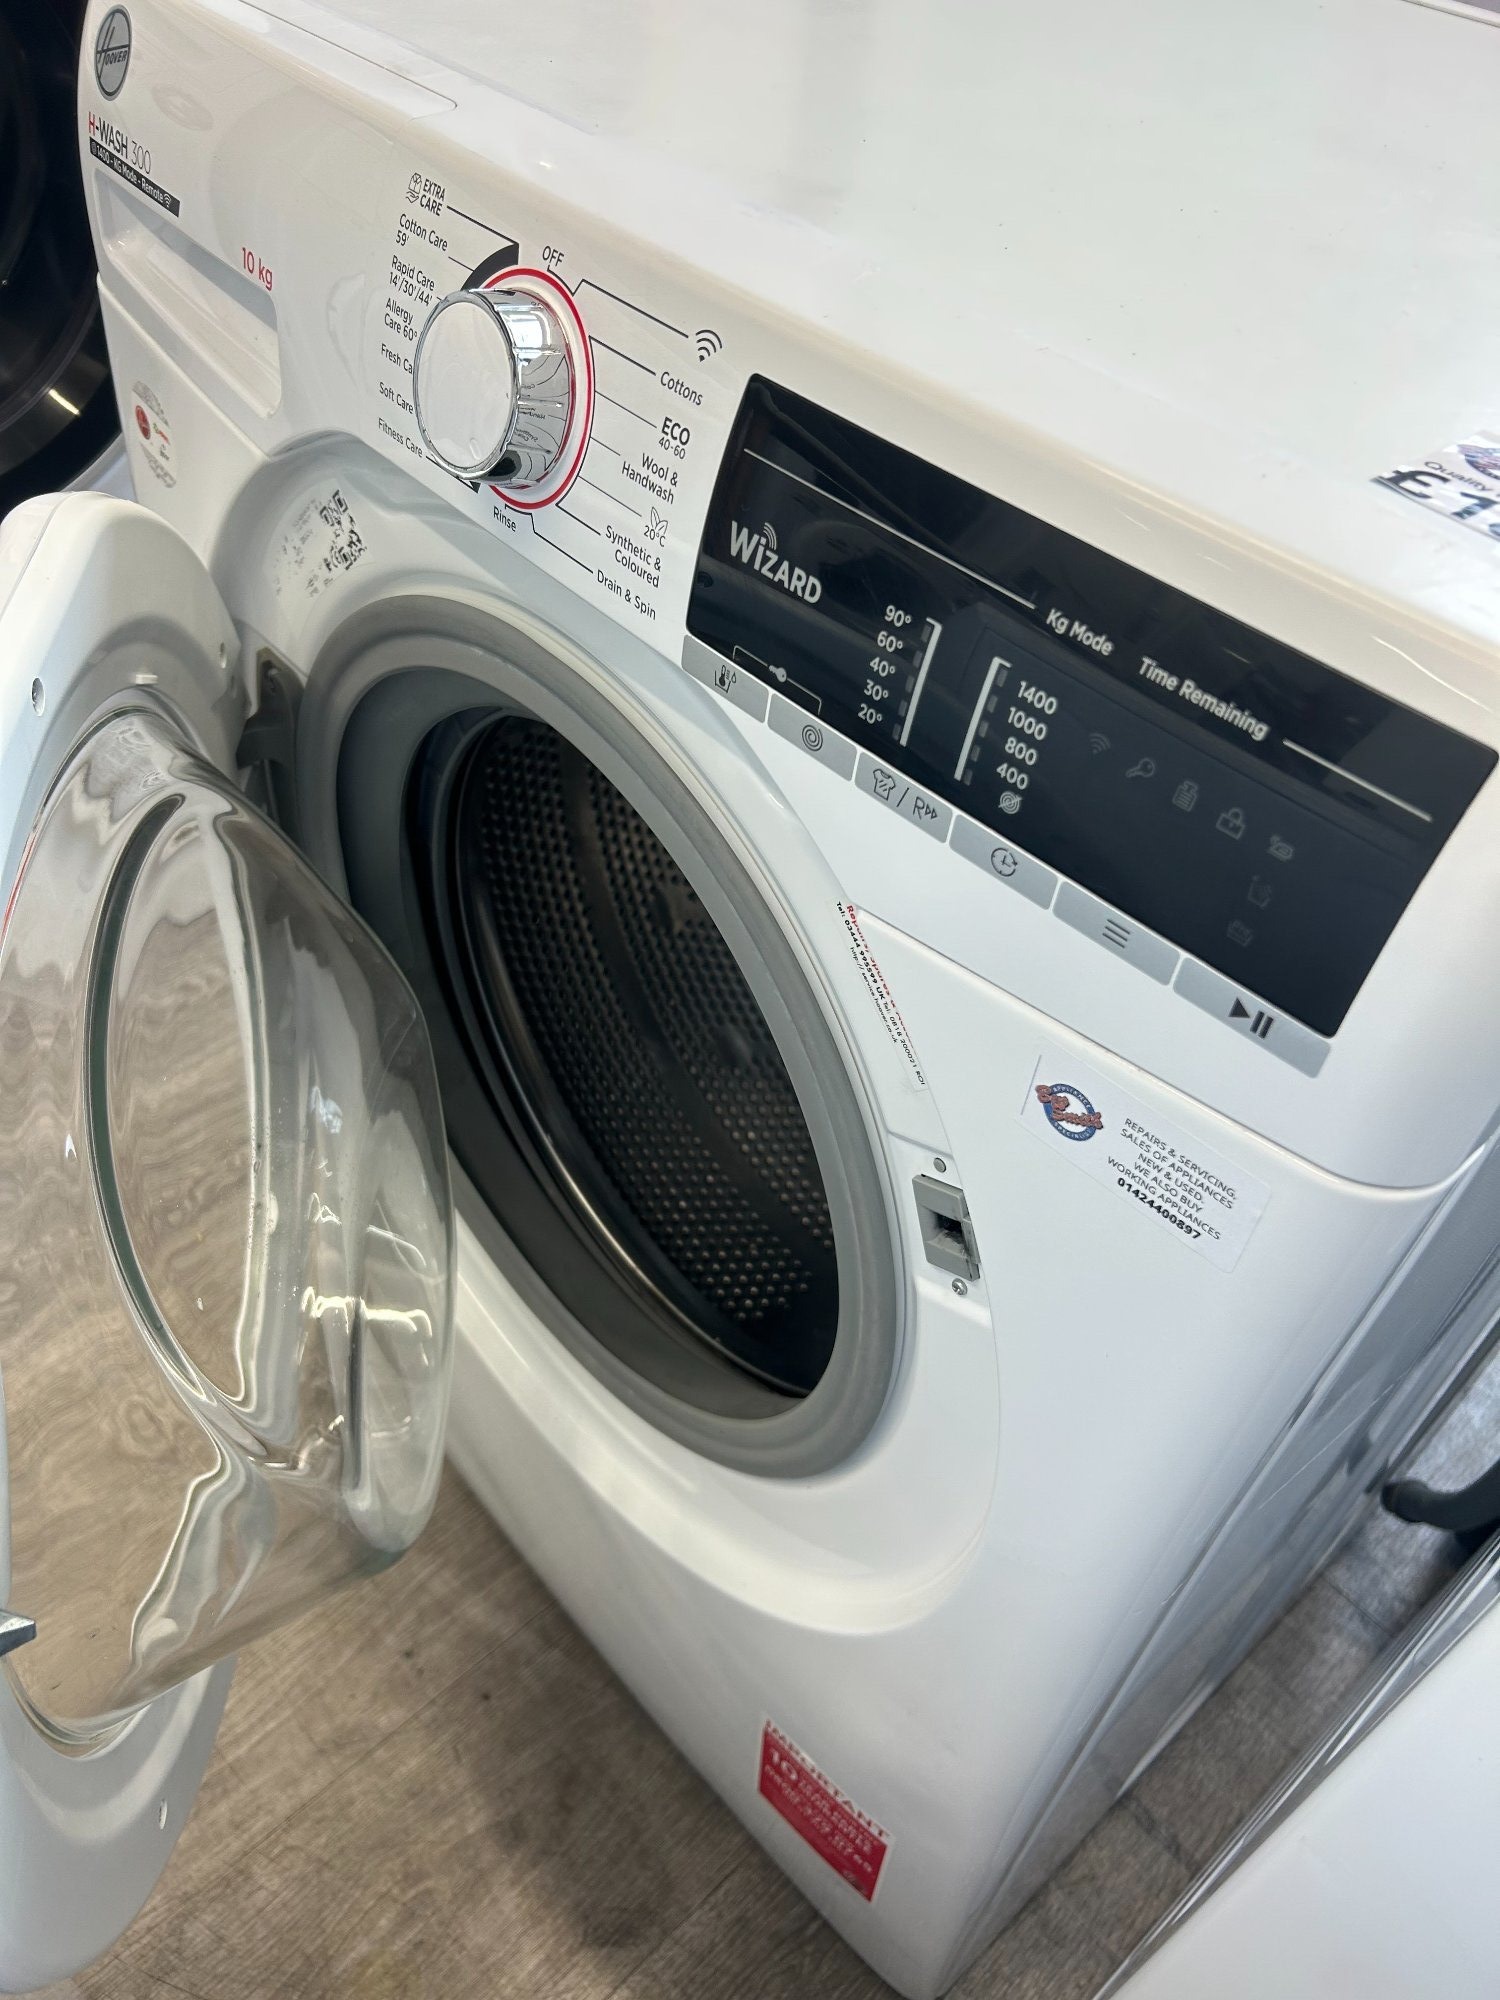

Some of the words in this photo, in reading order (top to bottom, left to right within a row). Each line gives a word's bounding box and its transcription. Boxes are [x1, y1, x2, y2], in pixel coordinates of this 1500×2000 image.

[88, 111, 128, 159] H-WASH
[131, 139, 151, 174] 300
[97, 145, 110, 163] 1400
[122, 166, 137, 184] Mode
[141, 178, 164, 203] Remote
[422, 178, 446, 202] EXTRA
[419, 194, 443, 216] CARE
[399, 213, 427, 240] Cotton
[428, 230, 448, 251] Care
[242, 247, 255, 274] 10
[258, 257, 273, 291] kg
[391, 255, 415, 280] Rapid
[416, 270, 435, 291] Care
[542, 245, 565, 267] OFF
[384, 313, 401, 334] Care
[403, 325, 418, 341] 60°
[385, 297, 414, 326] Allergy
[381, 343, 401, 367] Fresh
[403, 359, 413, 375] Ca
[379, 382, 395, 398] Soft
[396, 394, 413, 415] Care
[660, 371, 703, 406] Cottons
[378, 418, 404, 445] Fitness
[405, 437, 423, 458] Care
[658, 437, 686, 459] 40-60
[661, 416, 690, 446] ECO
[621, 461, 674, 504] Handwash
[641, 453, 669, 481] Wool
[670, 472, 678, 488] &
[493, 506, 517, 532] Rinse
[643, 525, 666, 548] 20°C
[605, 525, 651, 566] Synthetic
[654, 557, 661, 572] &
[614, 550, 659, 588] Coloured
[597, 569, 622, 597] Drain
[624, 588, 632, 604] &
[634, 595, 656, 620] Spin
[884, 605, 912, 627] 90°
[1046, 608, 1069, 636] Kg
[1069, 620, 1116, 657] Mode
[876, 630, 903, 653] 60°
[869, 656, 896, 678] 40°
[863, 679, 889, 702] 30°
[1016, 680, 1059, 715] 1400
[1138, 655, 1178, 693] Time
[1179, 678, 1271, 743] Remaining
[857, 703, 883, 725] 20°
[1007, 706, 1048, 741] 1000
[1003, 736, 1039, 766] 800
[996, 762, 1029, 790] 400
[836, 901, 846, 918] Tel:
[844, 919, 861, 948] 03444
[859, 950, 878, 984] 995599
[876, 986, 886, 1000] UK
[900, 1039, 917, 1068] 200021
[915, 1070, 926, 1085] ROI
[1120, 1128, 1152, 1154] SALES
[1152, 1151, 1168, 1164] OF
[1168, 1162, 1233, 1209] APPLIANCES
[1124, 1118, 1167, 1151] REPAIRS
[1167, 1148, 1176, 1159] &
[1177, 1155, 1238, 1200] SERVICING,
[1138, 1153, 1164, 1173] NEW
[1164, 1171, 1172, 1182] &
[1108, 1156, 1157, 1195] WORKING
[1157, 1193, 1222, 1240] APPLIANCES
[1134, 1162, 1151, 1178] WE
[1151, 1177, 1178, 1198] ALSO
[1179, 1194, 1203, 1214] BUY
[1117, 1177, 1202, 1239] 01424400897
